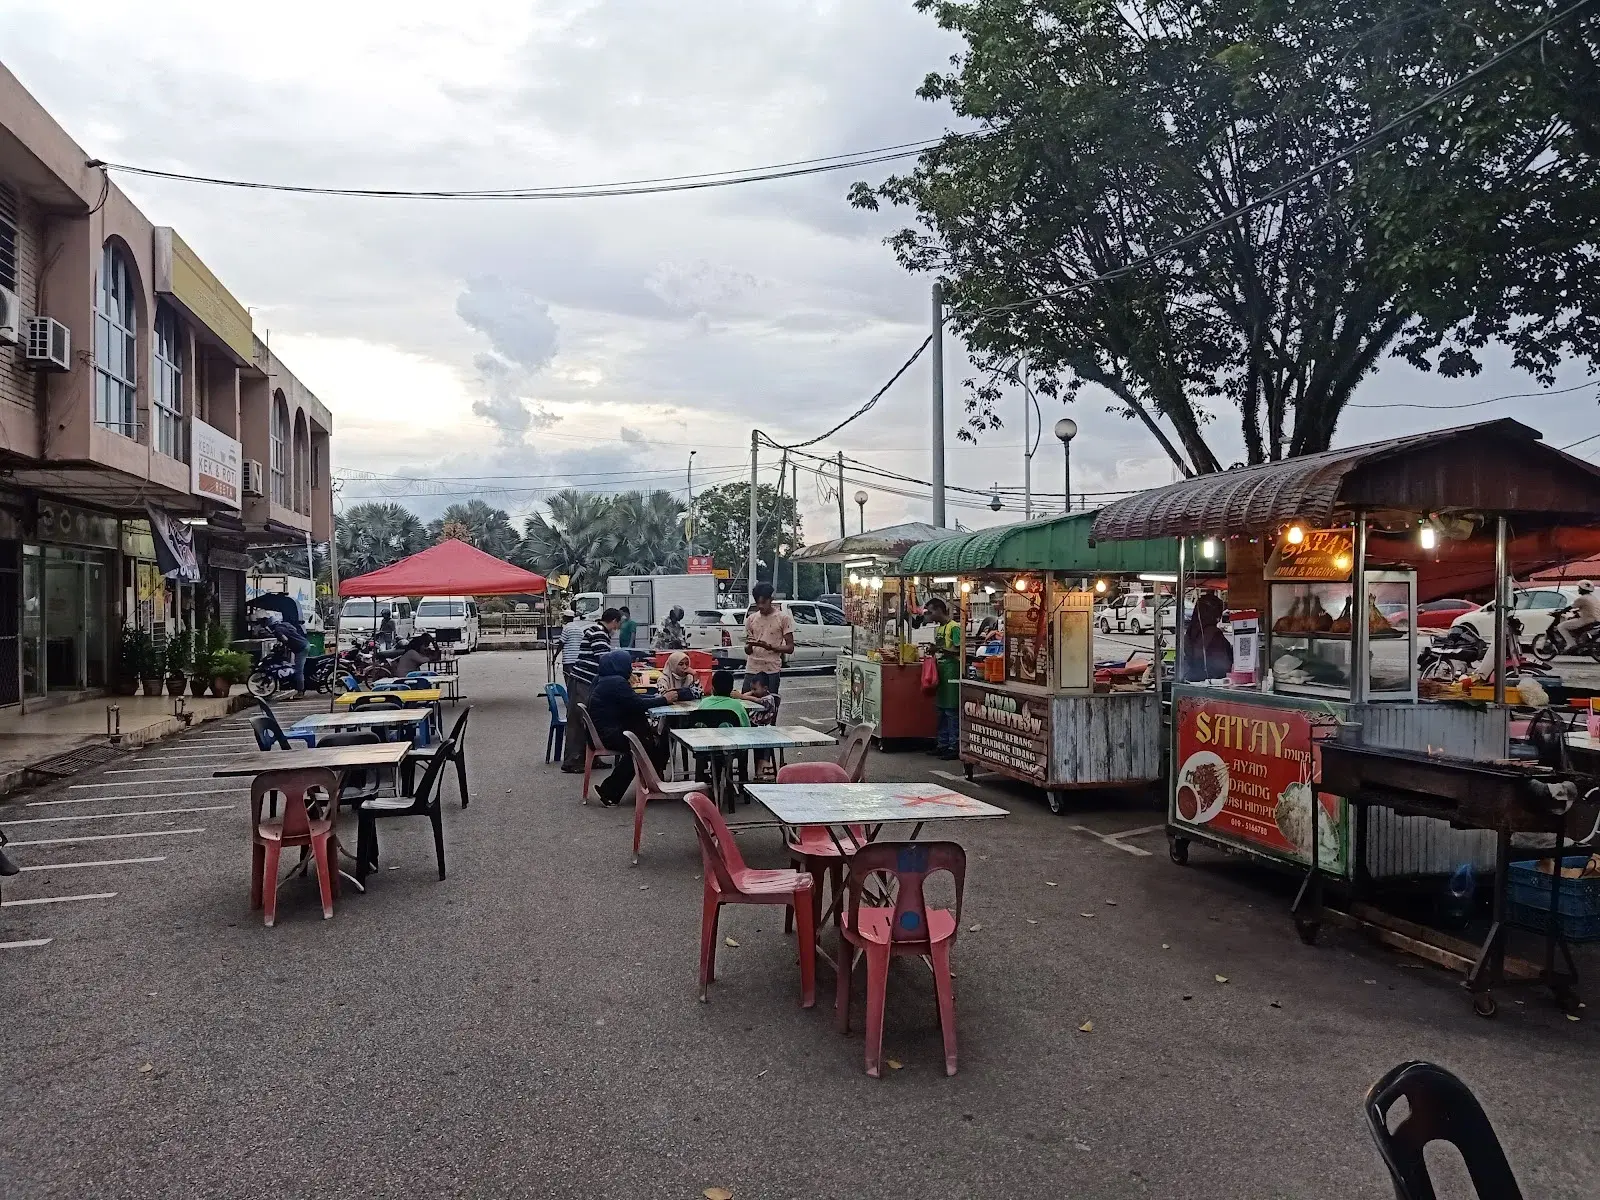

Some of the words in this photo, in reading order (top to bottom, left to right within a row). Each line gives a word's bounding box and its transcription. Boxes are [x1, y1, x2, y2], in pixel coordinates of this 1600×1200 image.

[199, 441, 216, 457] KEDAI
[199, 458, 213, 474] KEK
[215, 465, 220, 477] &
[222, 468, 237, 485] ROTI
[1281, 533, 1353, 561] SATAY
[1274, 567, 1295, 576] AYAM
[1298, 567, 1304, 576] &
[1305, 567, 1337, 577] DAGING
[984, 692, 1017, 713] ASWAD
[969, 732, 982, 743] MEE
[981, 737, 1011, 753] BANDUNG
[1012, 745, 1037, 762] UDANG
[971, 723, 1004, 739] KUEYTEOW
[1005, 732, 1033, 749] KERANG
[1195, 711, 1290, 757] SATAY
[969, 743, 983, 755] NASI
[983, 748, 1010, 765] GORENG
[1011, 757, 1035, 772] UDANG
[1233, 758, 1268, 778] AYAM
[1229, 779, 1271, 800] DAGING
